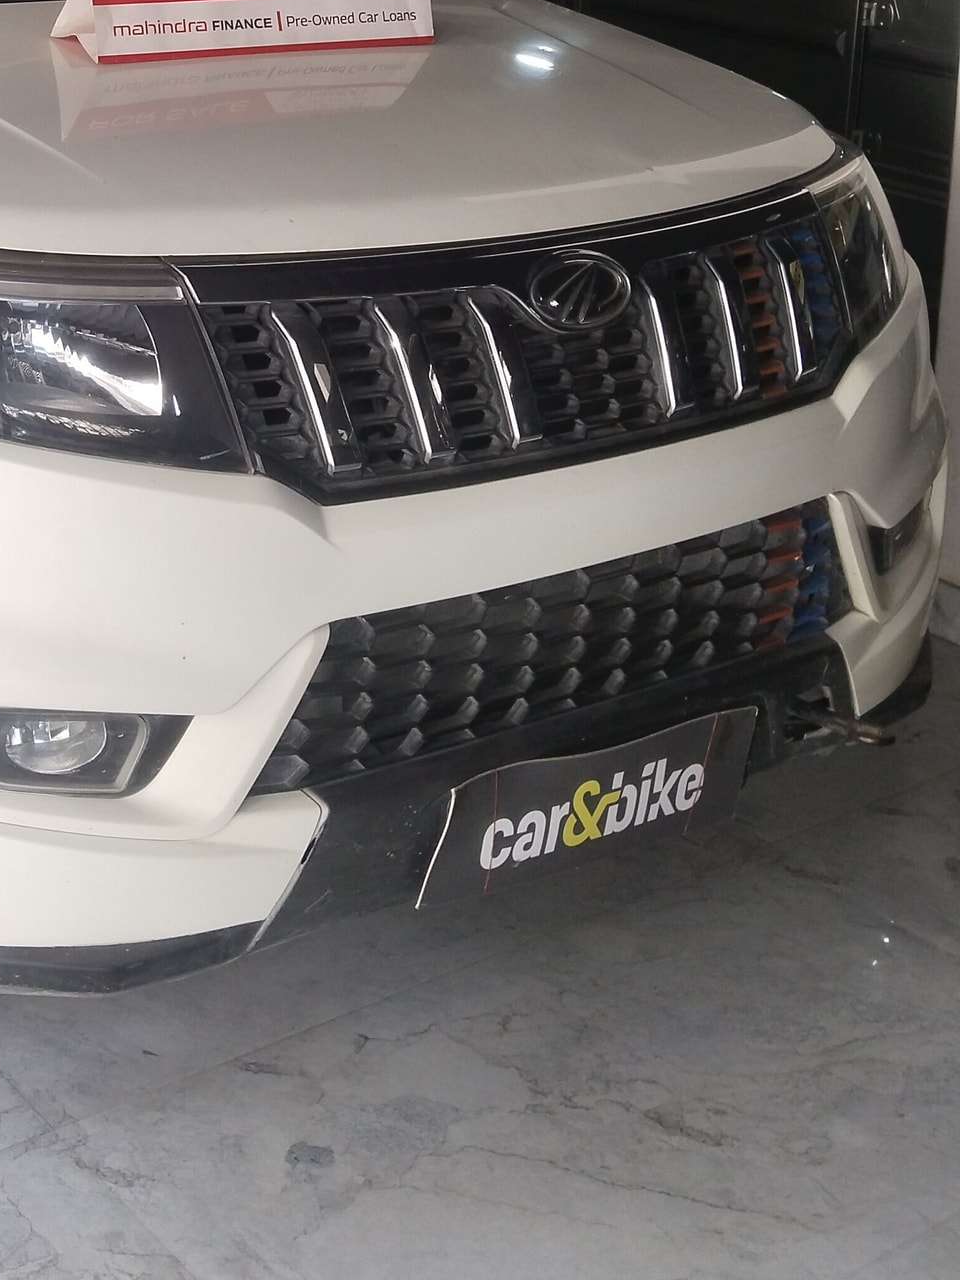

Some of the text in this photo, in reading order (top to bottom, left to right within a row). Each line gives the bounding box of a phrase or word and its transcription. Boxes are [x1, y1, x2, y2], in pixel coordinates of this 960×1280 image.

[113, 10, 417, 37] mahindra FINANCE Pre-Owned Car Loans
[479, 757, 705, 870] car&bike
